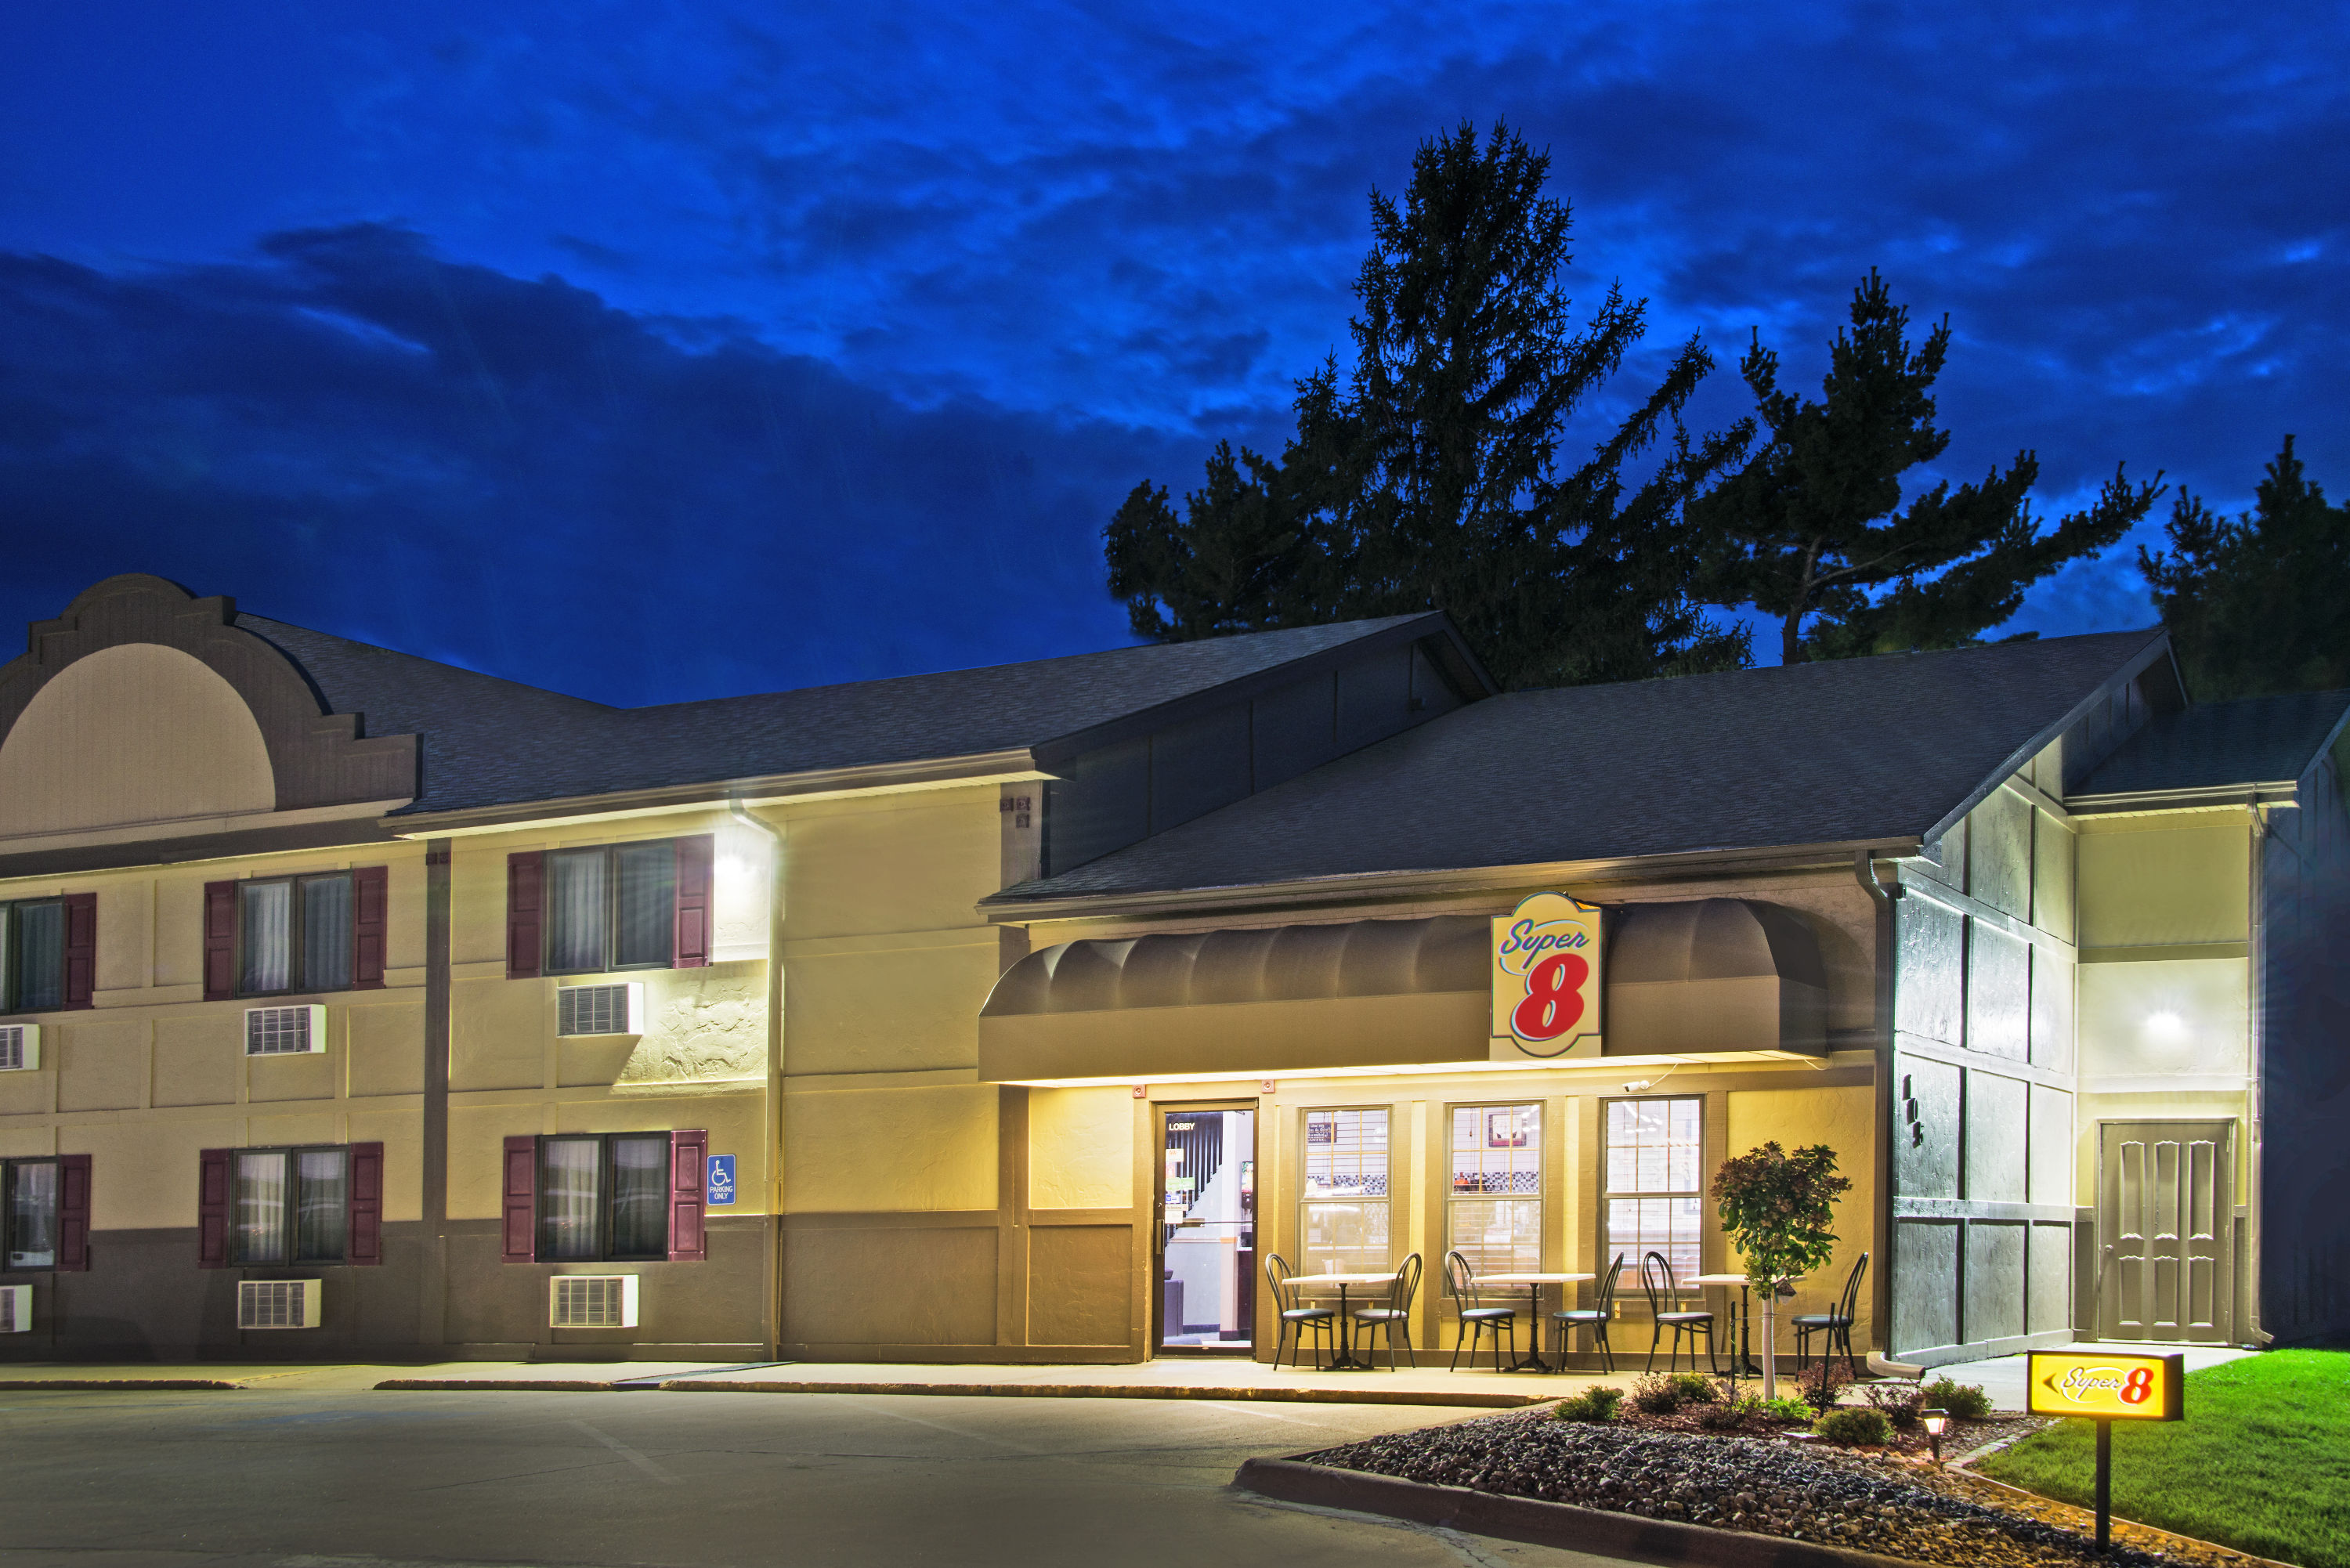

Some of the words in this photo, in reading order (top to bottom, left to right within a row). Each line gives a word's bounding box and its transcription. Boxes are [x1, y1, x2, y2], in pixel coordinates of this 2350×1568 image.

[1499, 919, 1590, 970] Super
[1509, 953, 1589, 1042] 8
[1169, 1122, 1195, 1131] LOBBY
[2061, 1367, 2121, 1400] Super
[2117, 1367, 2154, 1406] 8
